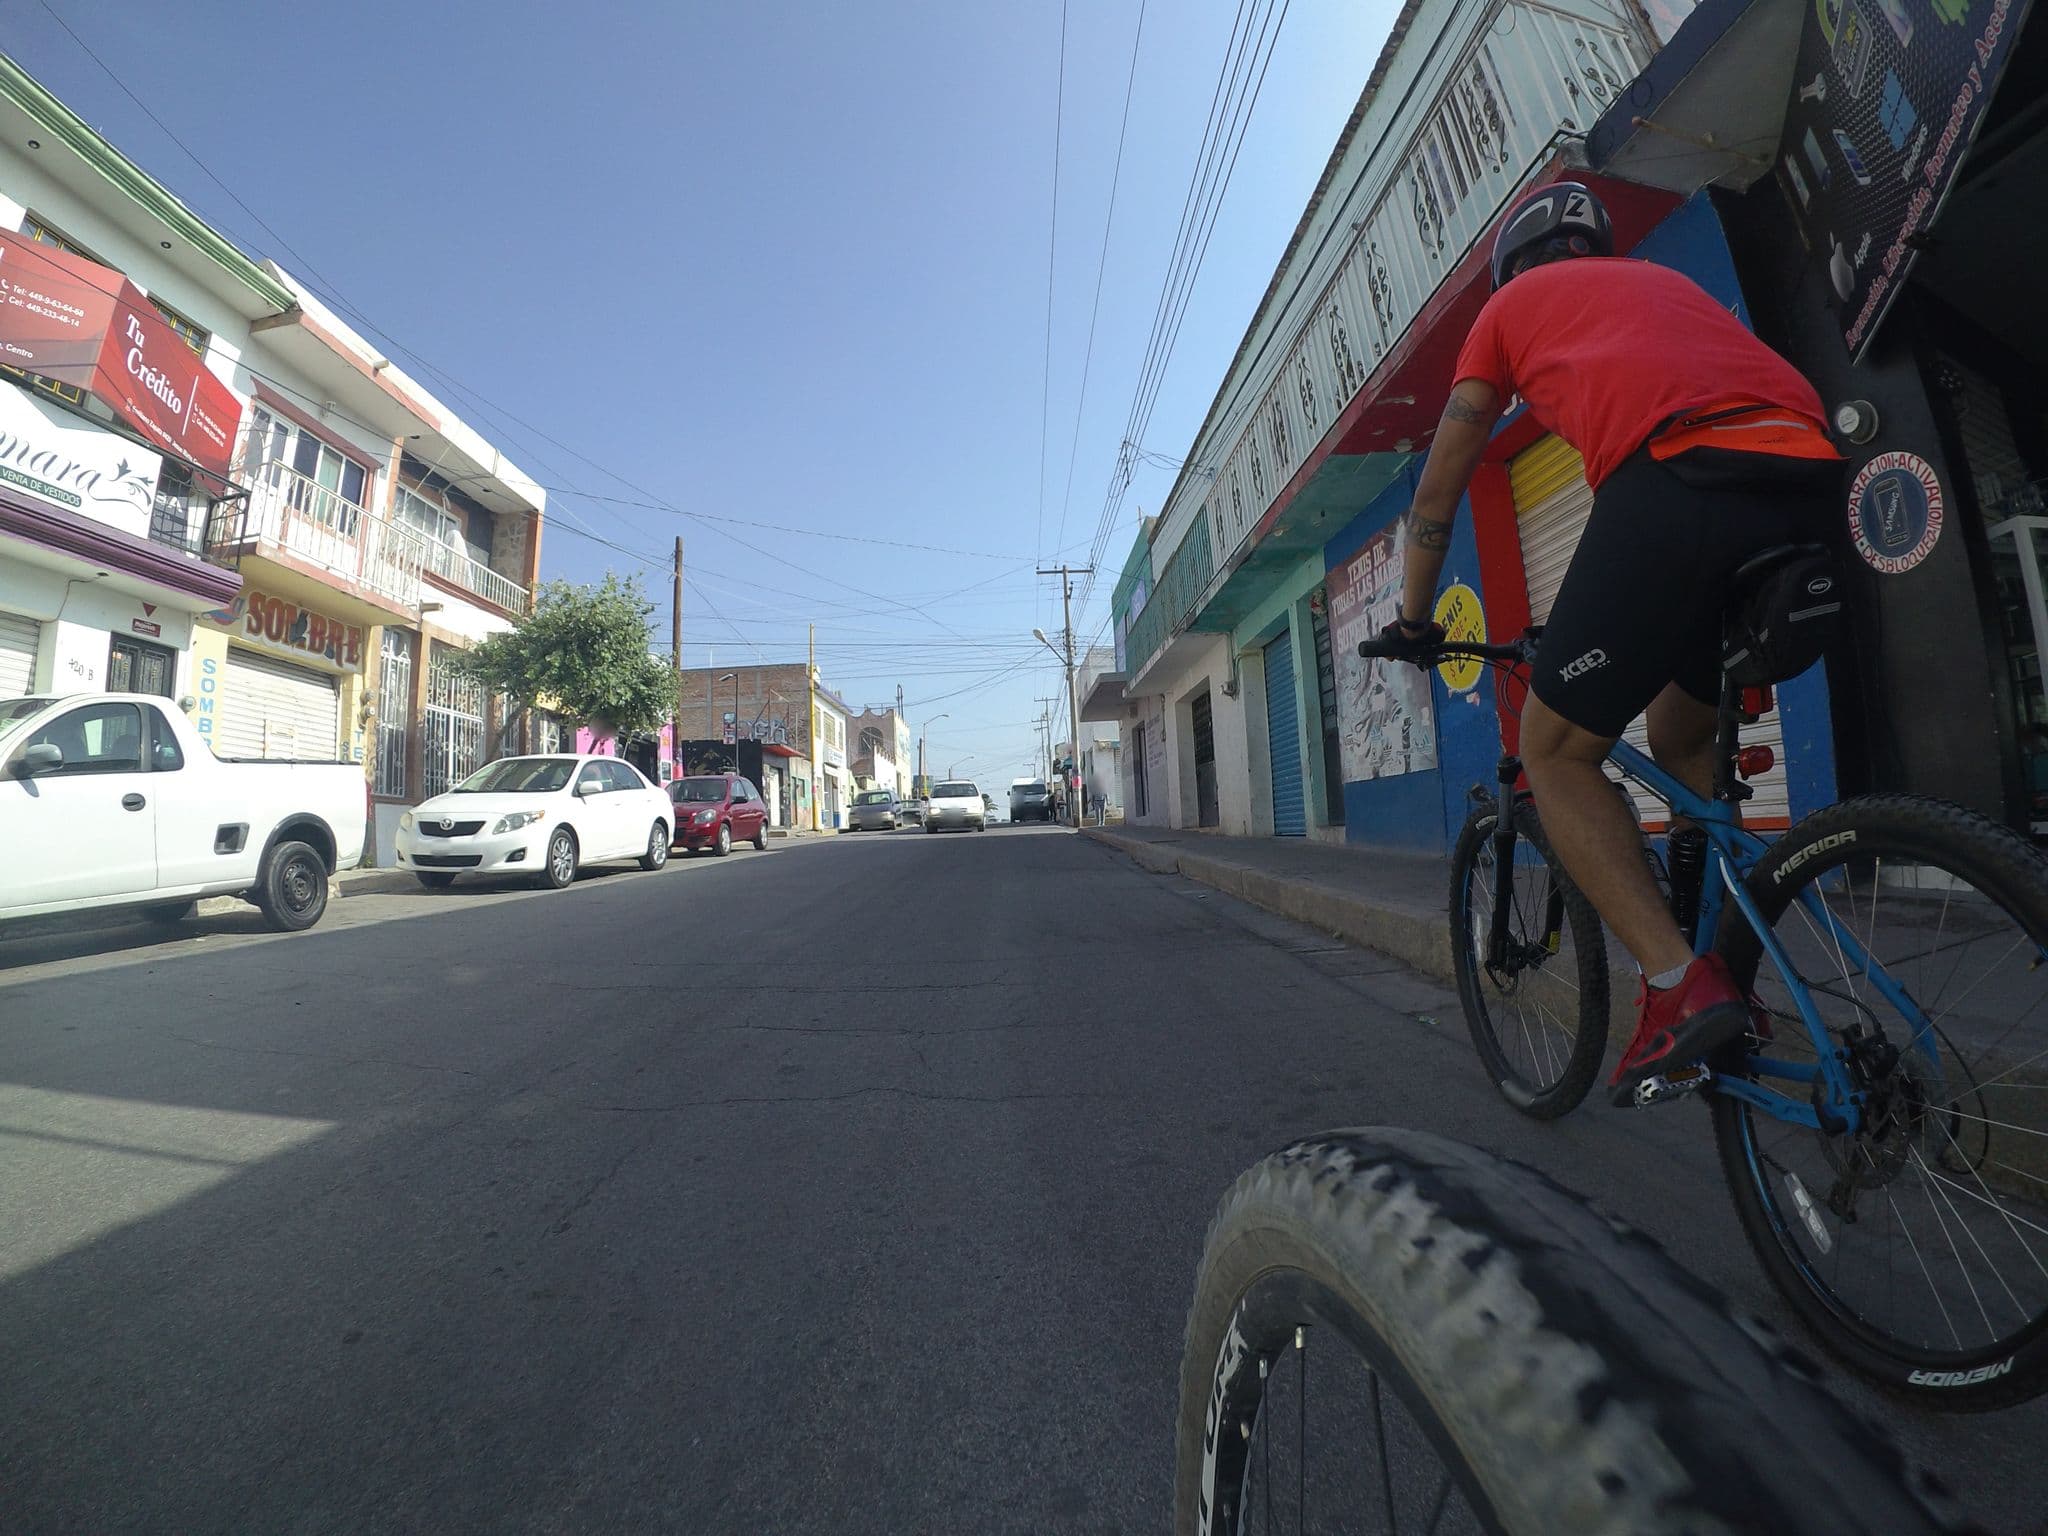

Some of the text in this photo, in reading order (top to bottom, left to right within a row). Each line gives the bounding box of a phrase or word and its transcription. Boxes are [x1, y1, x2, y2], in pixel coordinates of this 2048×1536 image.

[1923, 82, 1974, 189] Formateo
[1968, 61, 1983, 93] y
[1901, 122, 1928, 182] Windows
[1854, 232, 1872, 270] Apple
[6, 343, 34, 359] Centro
[125, 313, 145, 348] Tu
[126, 347, 182, 414] Crédito
[2, 468, 81, 507] VENTA DE VESTIDOS
[1849, 453, 1896, 543] REPARACION
[1885, 492, 1900, 533] SAMSUNG
[1347, 540, 1387, 585] TENIS DE
[1356, 573, 1374, 602] LAS
[1773, 829, 1857, 885] MERIDA
[1907, 1355, 2015, 1387] MERIDA
